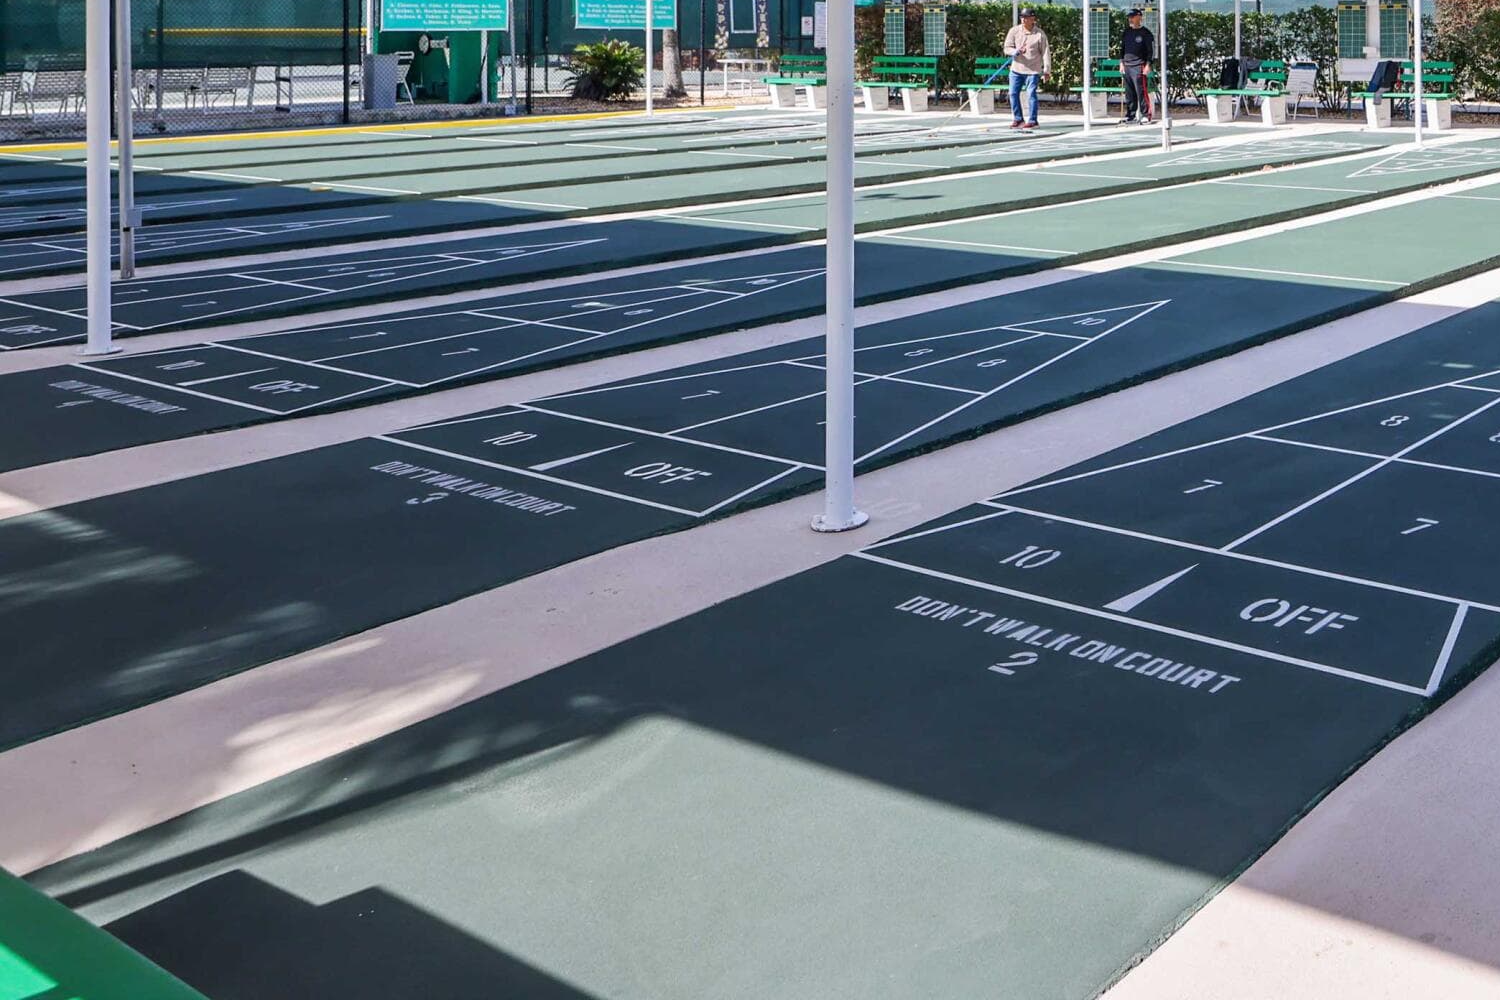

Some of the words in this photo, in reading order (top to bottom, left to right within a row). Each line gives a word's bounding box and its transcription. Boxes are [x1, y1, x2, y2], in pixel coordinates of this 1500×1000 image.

[977, 359, 1007, 367] 8
[1381, 416, 1409, 426] 8
[483, 431, 537, 445] 10
[624, 463, 712, 483] OFF
[1184, 479, 1222, 493] 7
[1401, 518, 1438, 534] 7
[1000, 546, 1061, 568] 10
[1240, 599, 1358, 634] OFF
[894, 595, 996, 628] DON'T
[984, 617, 1082, 651] WALK
[1069, 640, 1126, 664] ON
[1114, 651, 1241, 695] COURT
[988, 651, 1039, 677] 2
